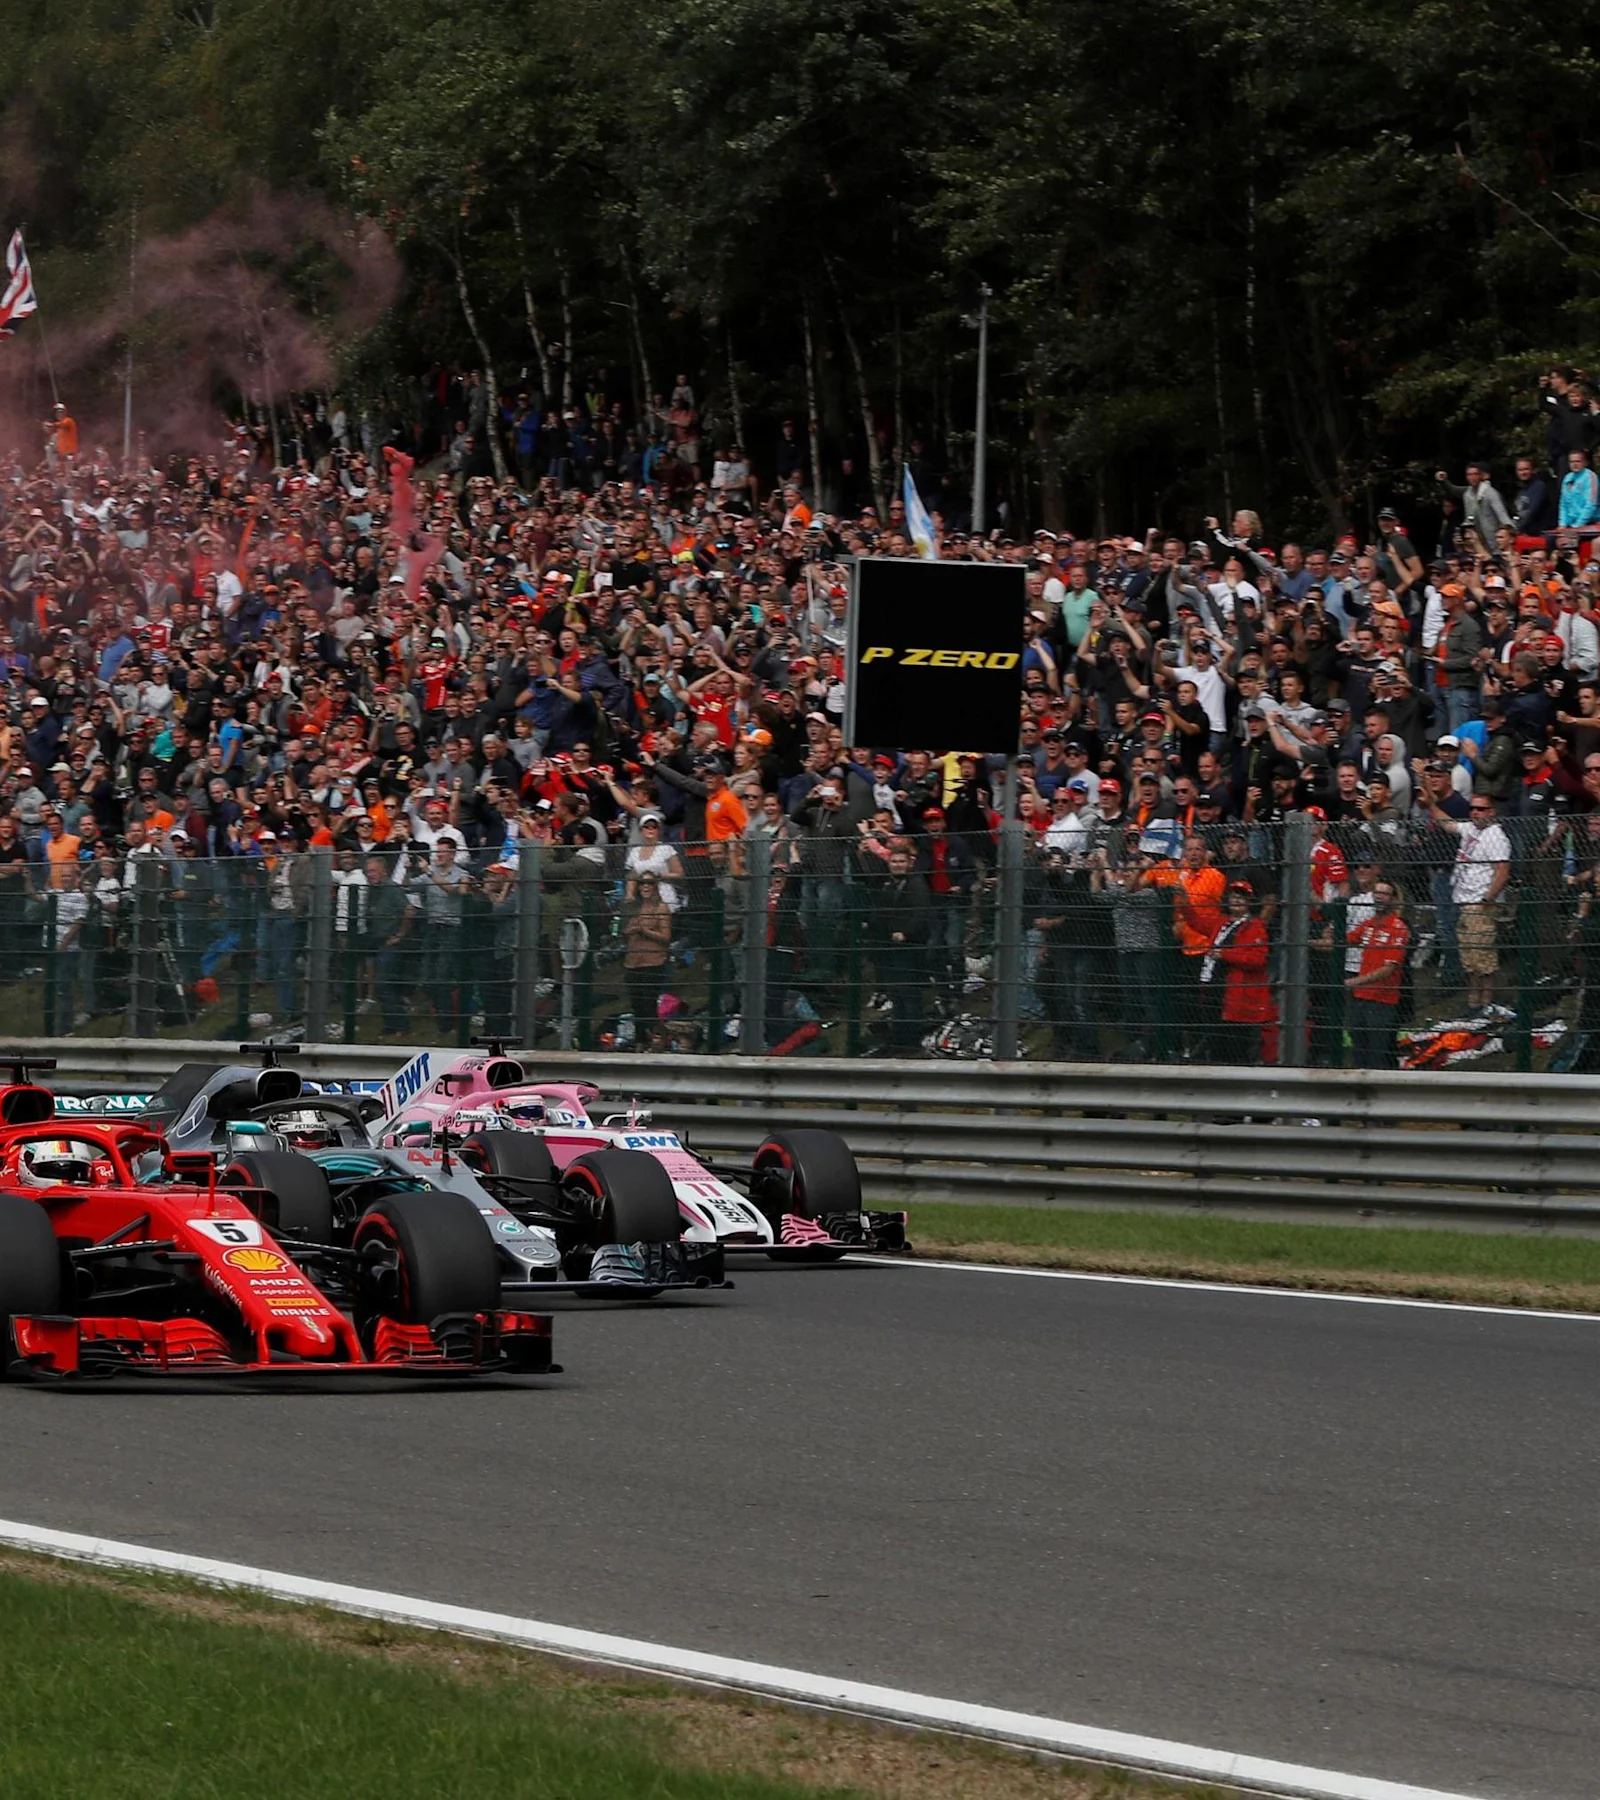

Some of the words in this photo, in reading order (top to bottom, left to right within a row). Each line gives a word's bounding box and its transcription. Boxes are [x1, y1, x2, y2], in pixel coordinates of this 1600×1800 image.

[860, 646, 894, 664] P
[898, 648, 1020, 670] ZERO
[395, 1052, 430, 1107] BWT
[380, 1083, 395, 1121] 11
[623, 1136, 680, 1149] BWT
[685, 1183, 723, 1197] 11
[707, 1199, 749, 1224] HYPE
[212, 1222, 249, 1243] 5
[249, 1278, 289, 1286] AMD
[270, 1308, 331, 1316] MAHLE
